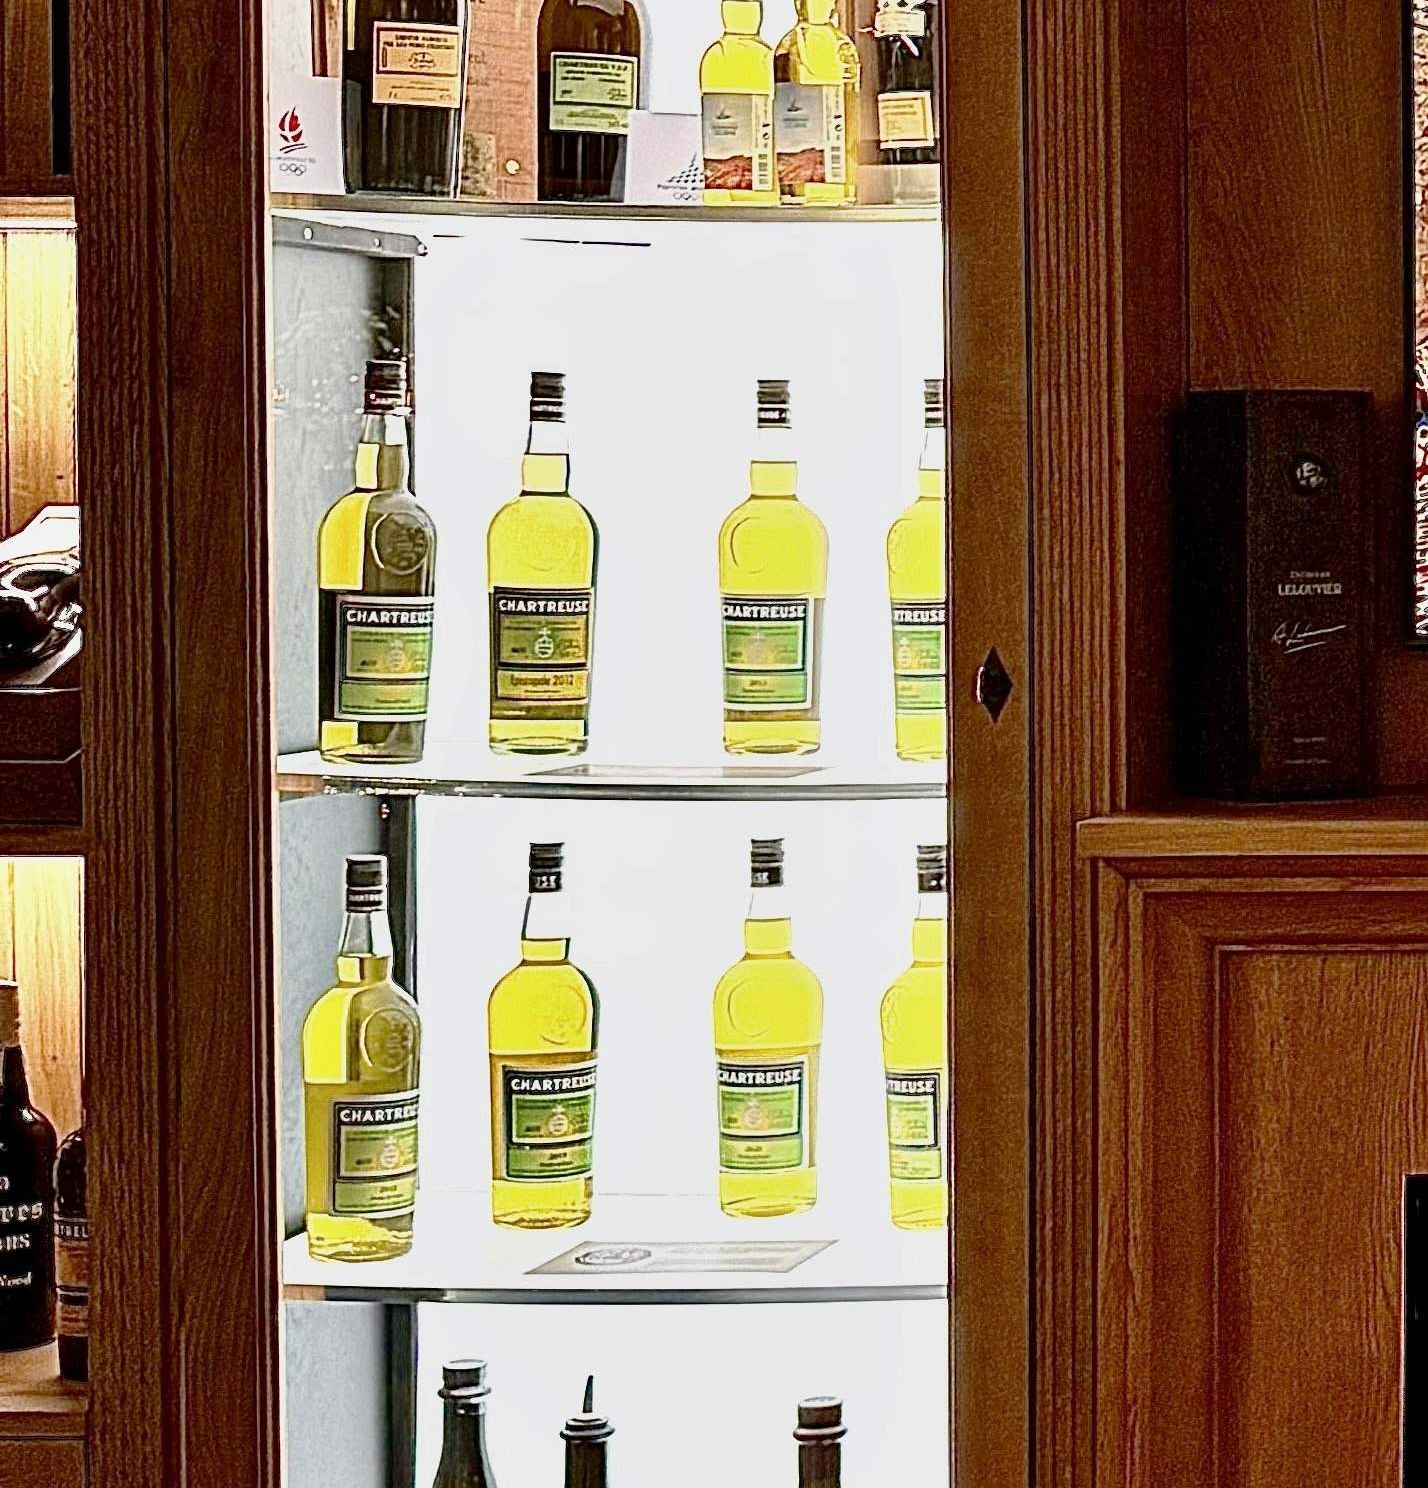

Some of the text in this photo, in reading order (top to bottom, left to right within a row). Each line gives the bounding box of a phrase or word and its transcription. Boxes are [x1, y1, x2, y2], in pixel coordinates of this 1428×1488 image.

[498, 598, 590, 613] CHARTREUSE
[722, 605, 806, 619] CHARTREUSE
[346, 609, 434, 624] CHARTREUS
[719, 1068, 802, 1086] CHARTREUSE
